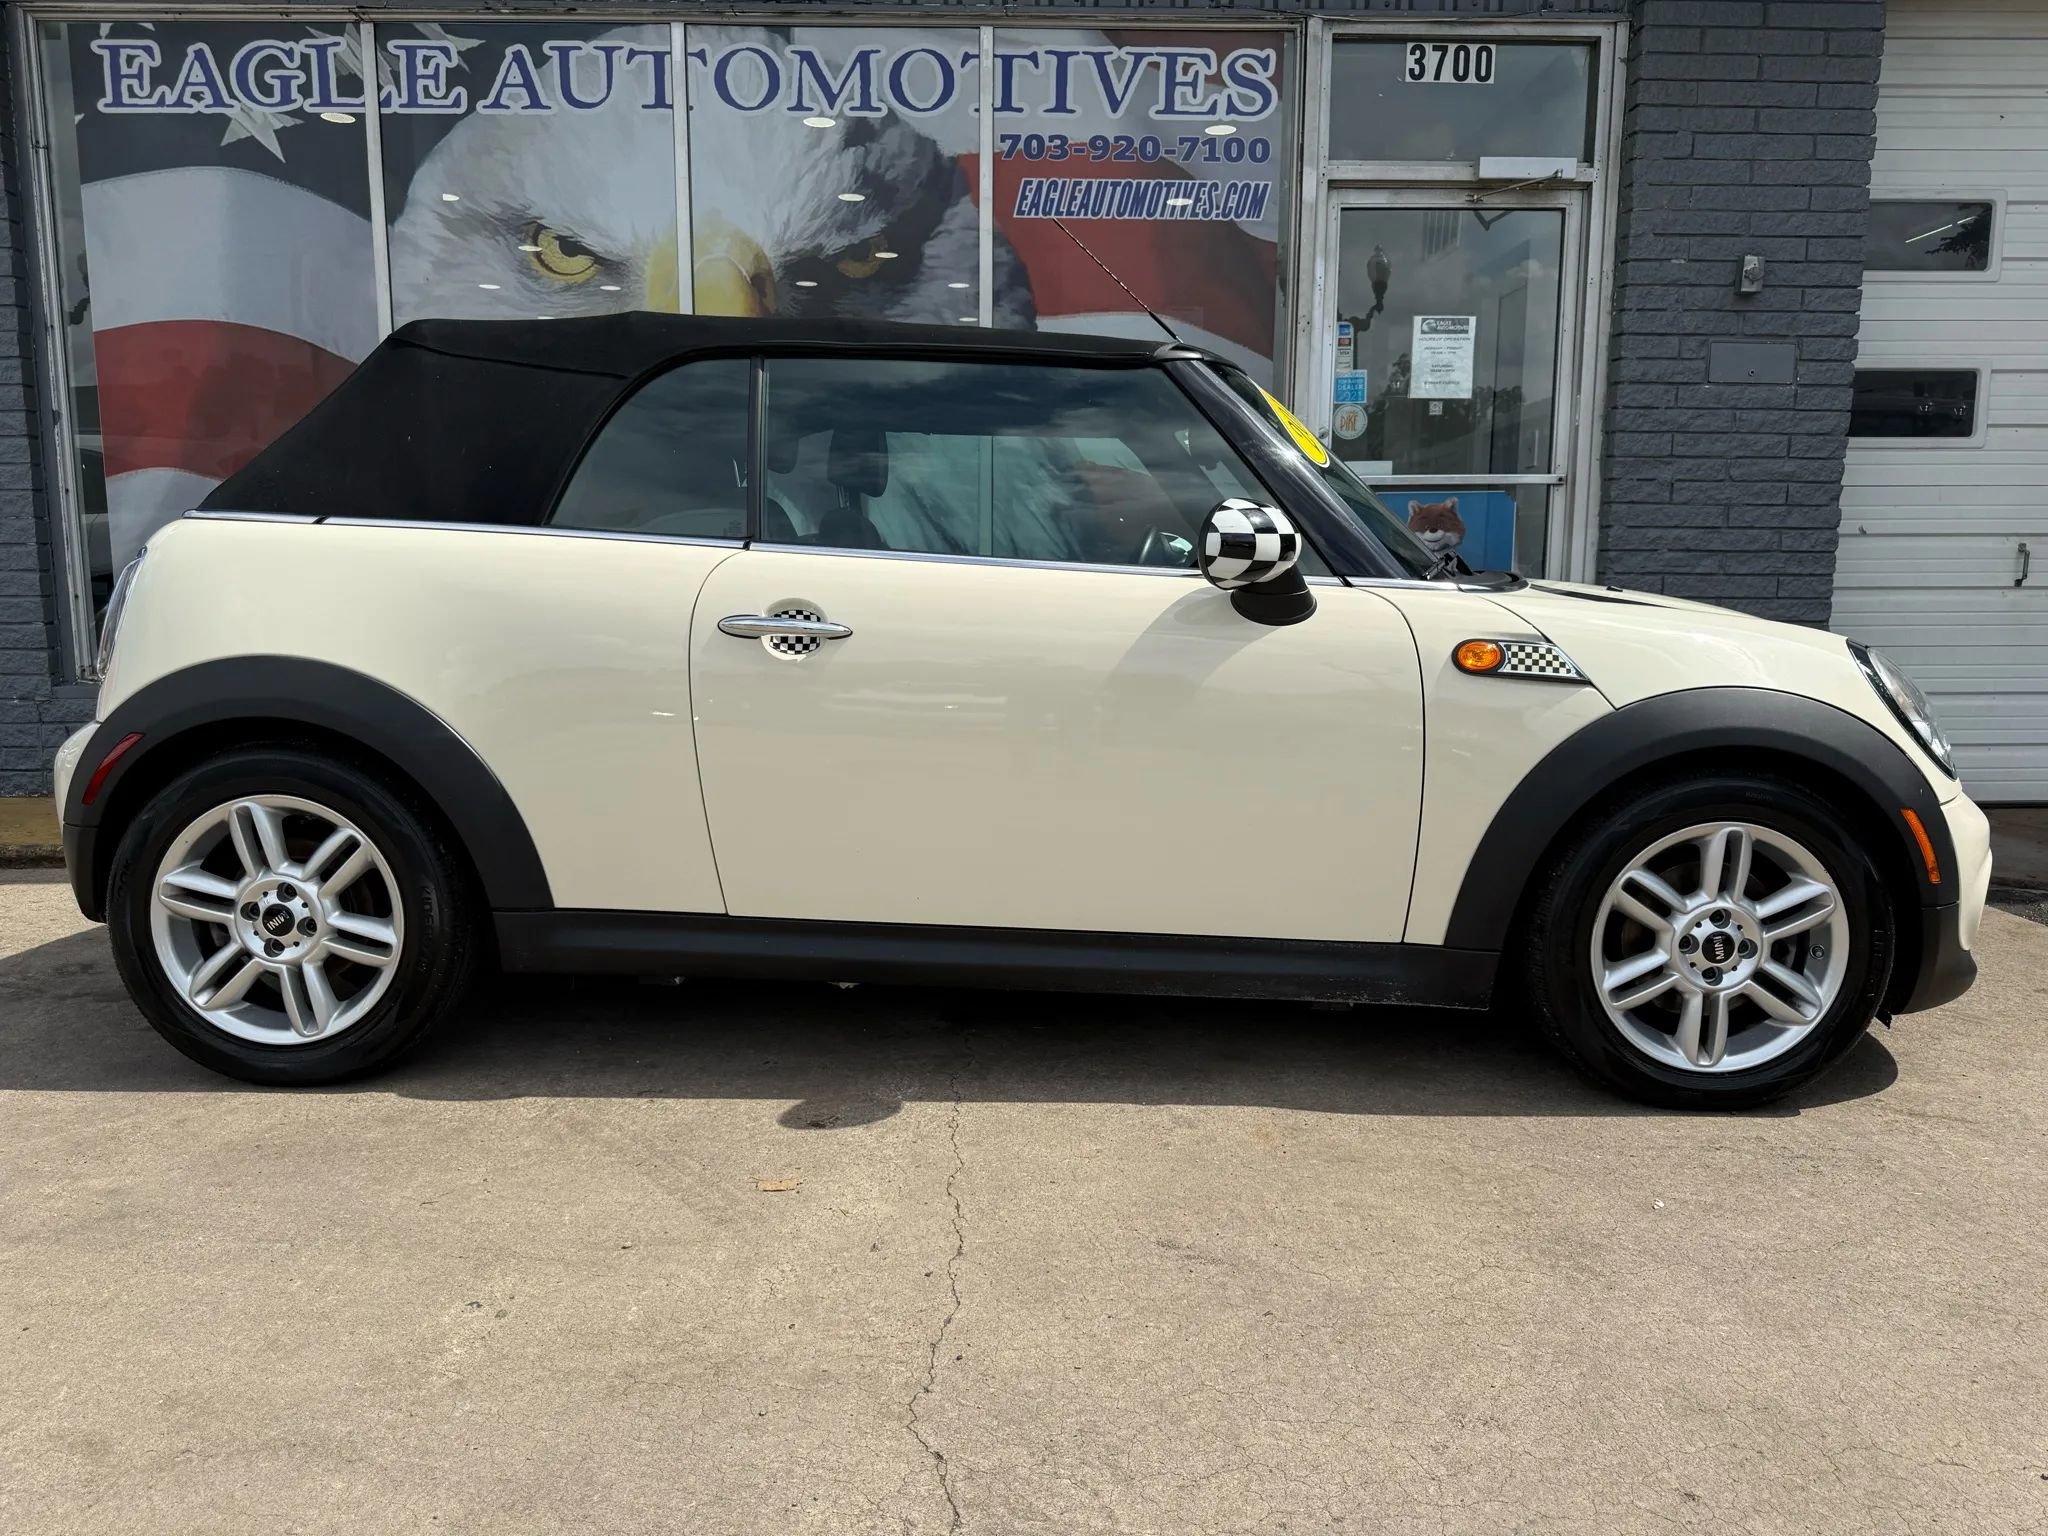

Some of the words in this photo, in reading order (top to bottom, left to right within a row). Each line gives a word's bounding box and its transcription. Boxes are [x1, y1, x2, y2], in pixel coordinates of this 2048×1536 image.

[92, 38, 469, 116] EAGLE
[478, 39, 1280, 121] AUTOMOTIVES
[1408, 43, 1494, 83] 3700
[1000, 132, 1272, 165] 703-920-7100
[1012, 178, 1273, 222] EAGLEAUTOMOTIVES.COM
[267, 910, 290, 931] MINI
[1712, 935, 1726, 961] MINI
